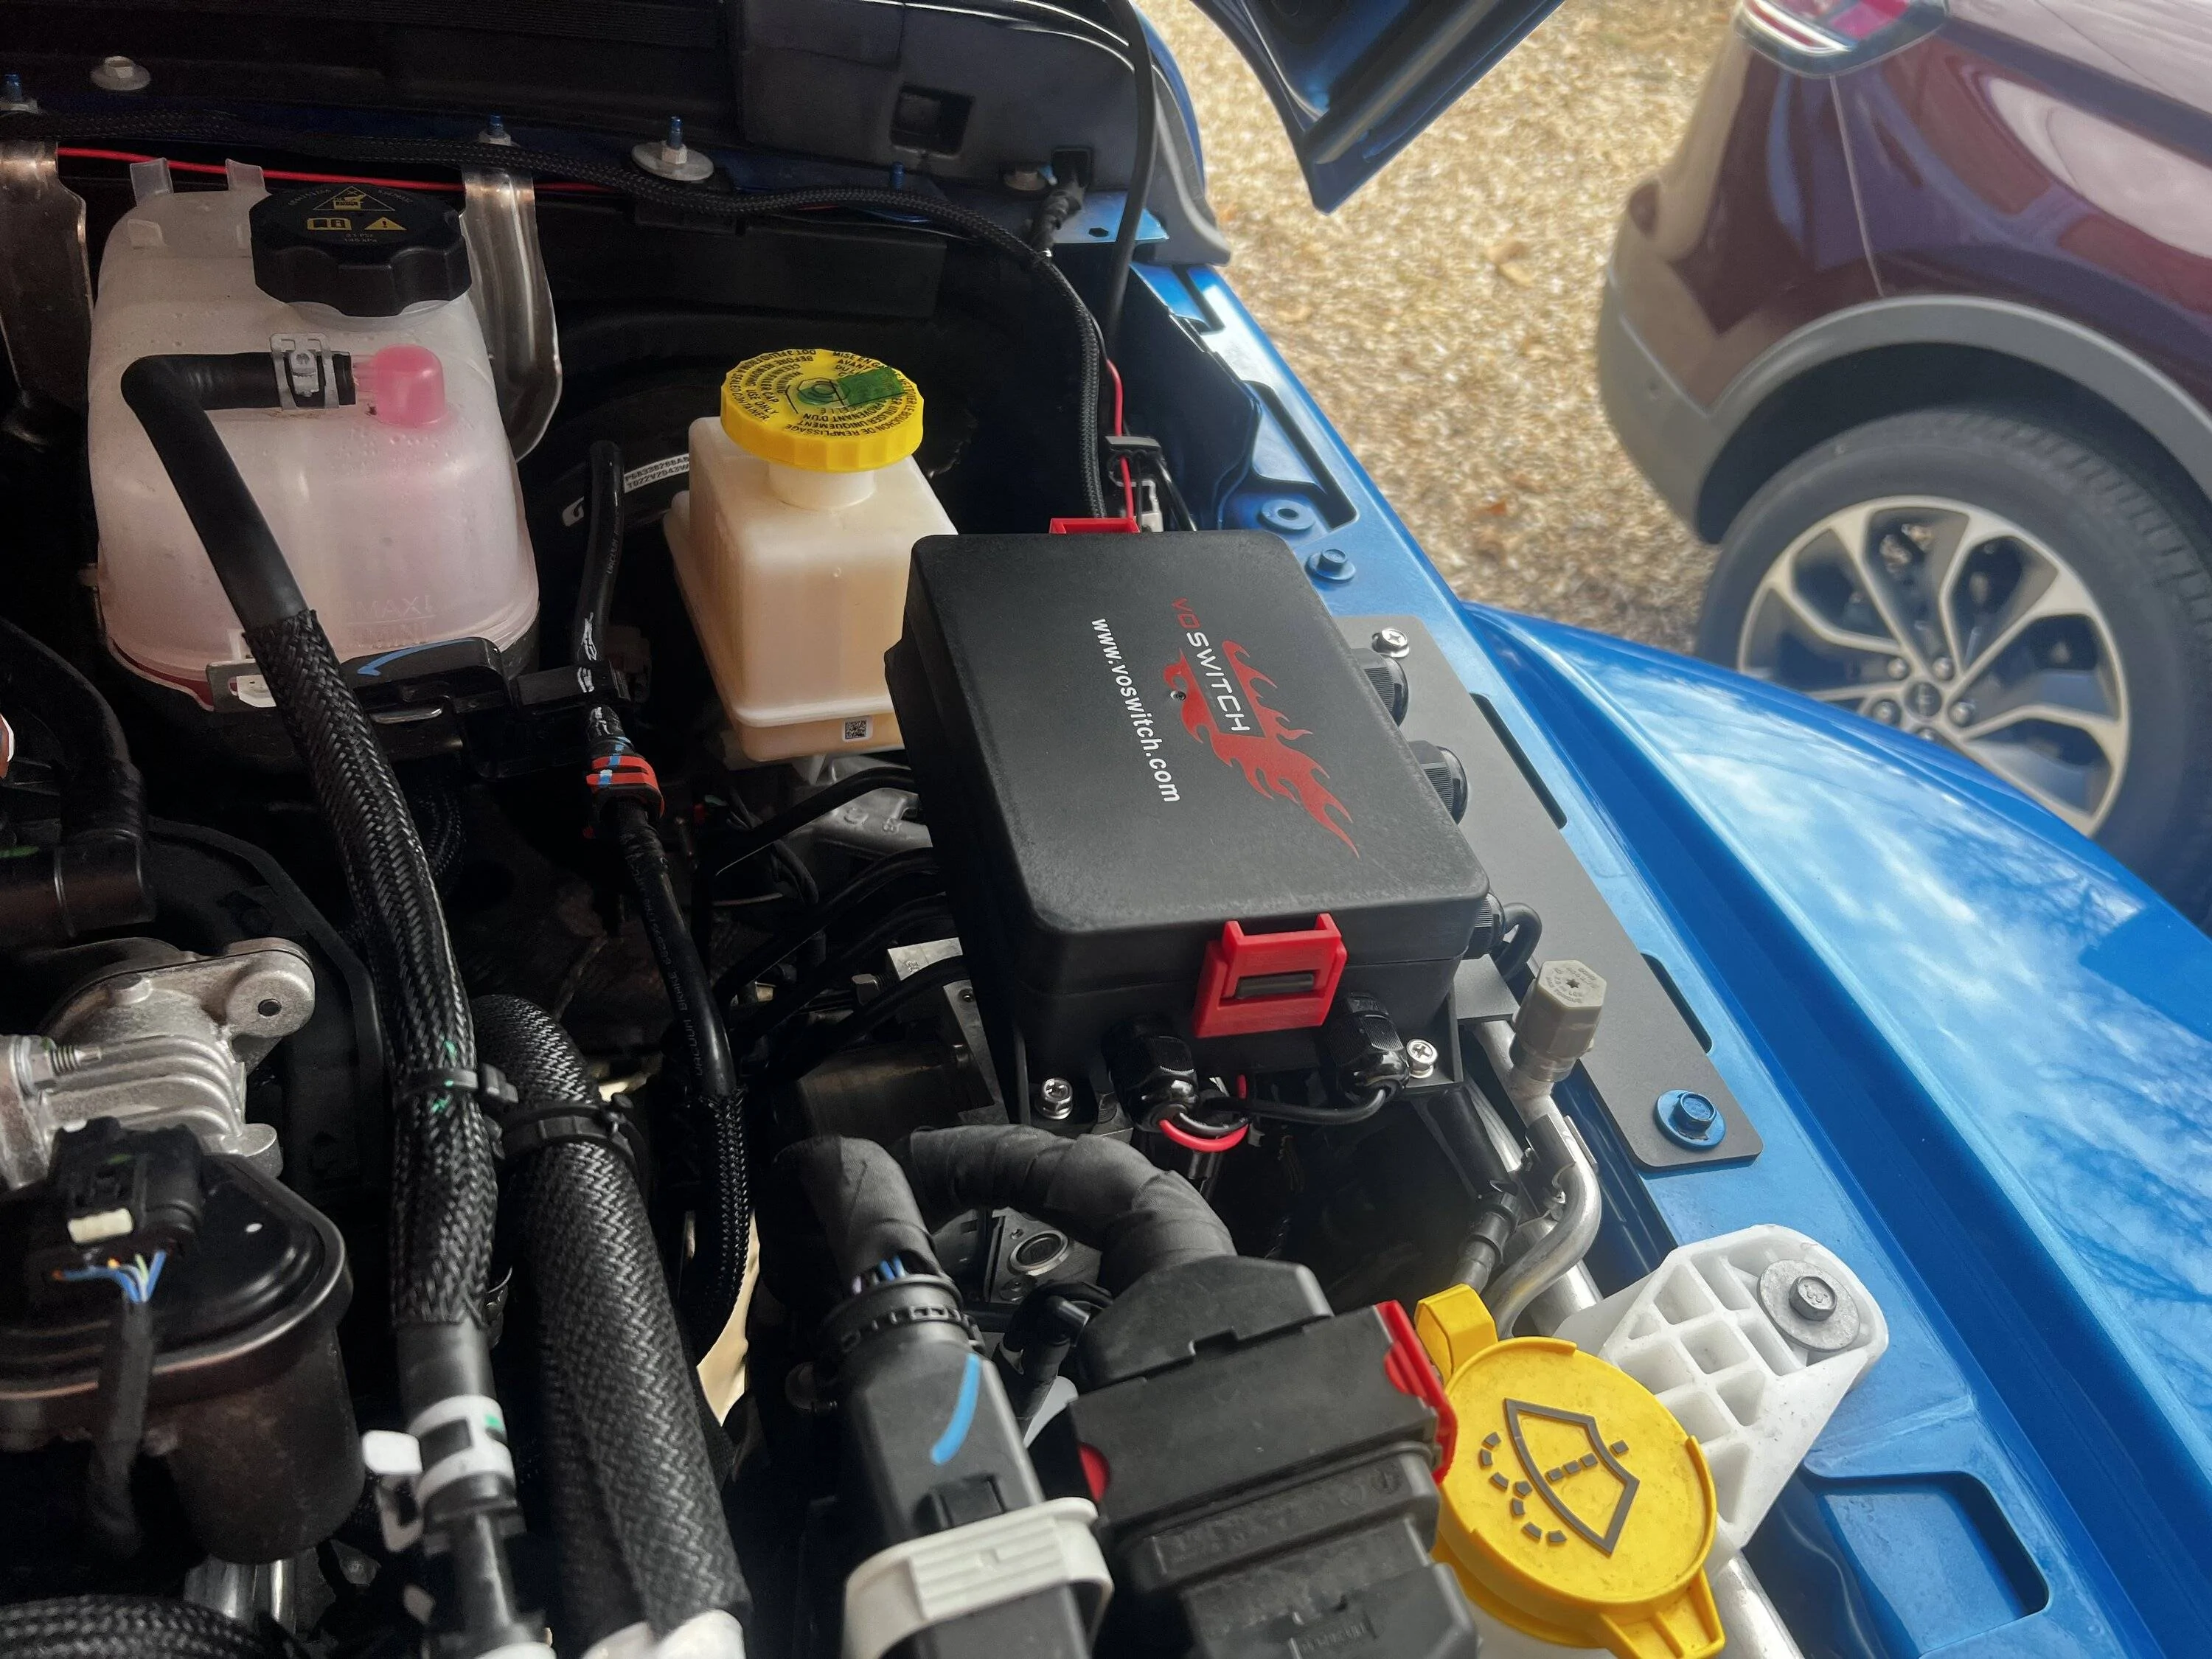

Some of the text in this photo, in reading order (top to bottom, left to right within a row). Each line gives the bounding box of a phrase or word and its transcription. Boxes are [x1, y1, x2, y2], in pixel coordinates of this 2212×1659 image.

[773, 355, 814, 366] BEFORE
[832, 352, 855, 361] MISE
[837, 359, 871, 371] AVANT
[729, 373, 744, 392] SEALED
[760, 373, 778, 392] FILLER
[745, 389, 761, 400] USE
[762, 392, 779, 403] CAP
[754, 402, 779, 415] ONLY
[802, 402, 885, 422] PROVENANT D'UN
[796, 406, 898, 431] UTILISER UNIQUEMENT
[874, 411, 912, 430] BOUCHON
[785, 423, 860, 437] REMPLISSAGE
[1171, 597, 1251, 732] VOSWITCH
[1091, 618, 1180, 802] www.voswitch.com
